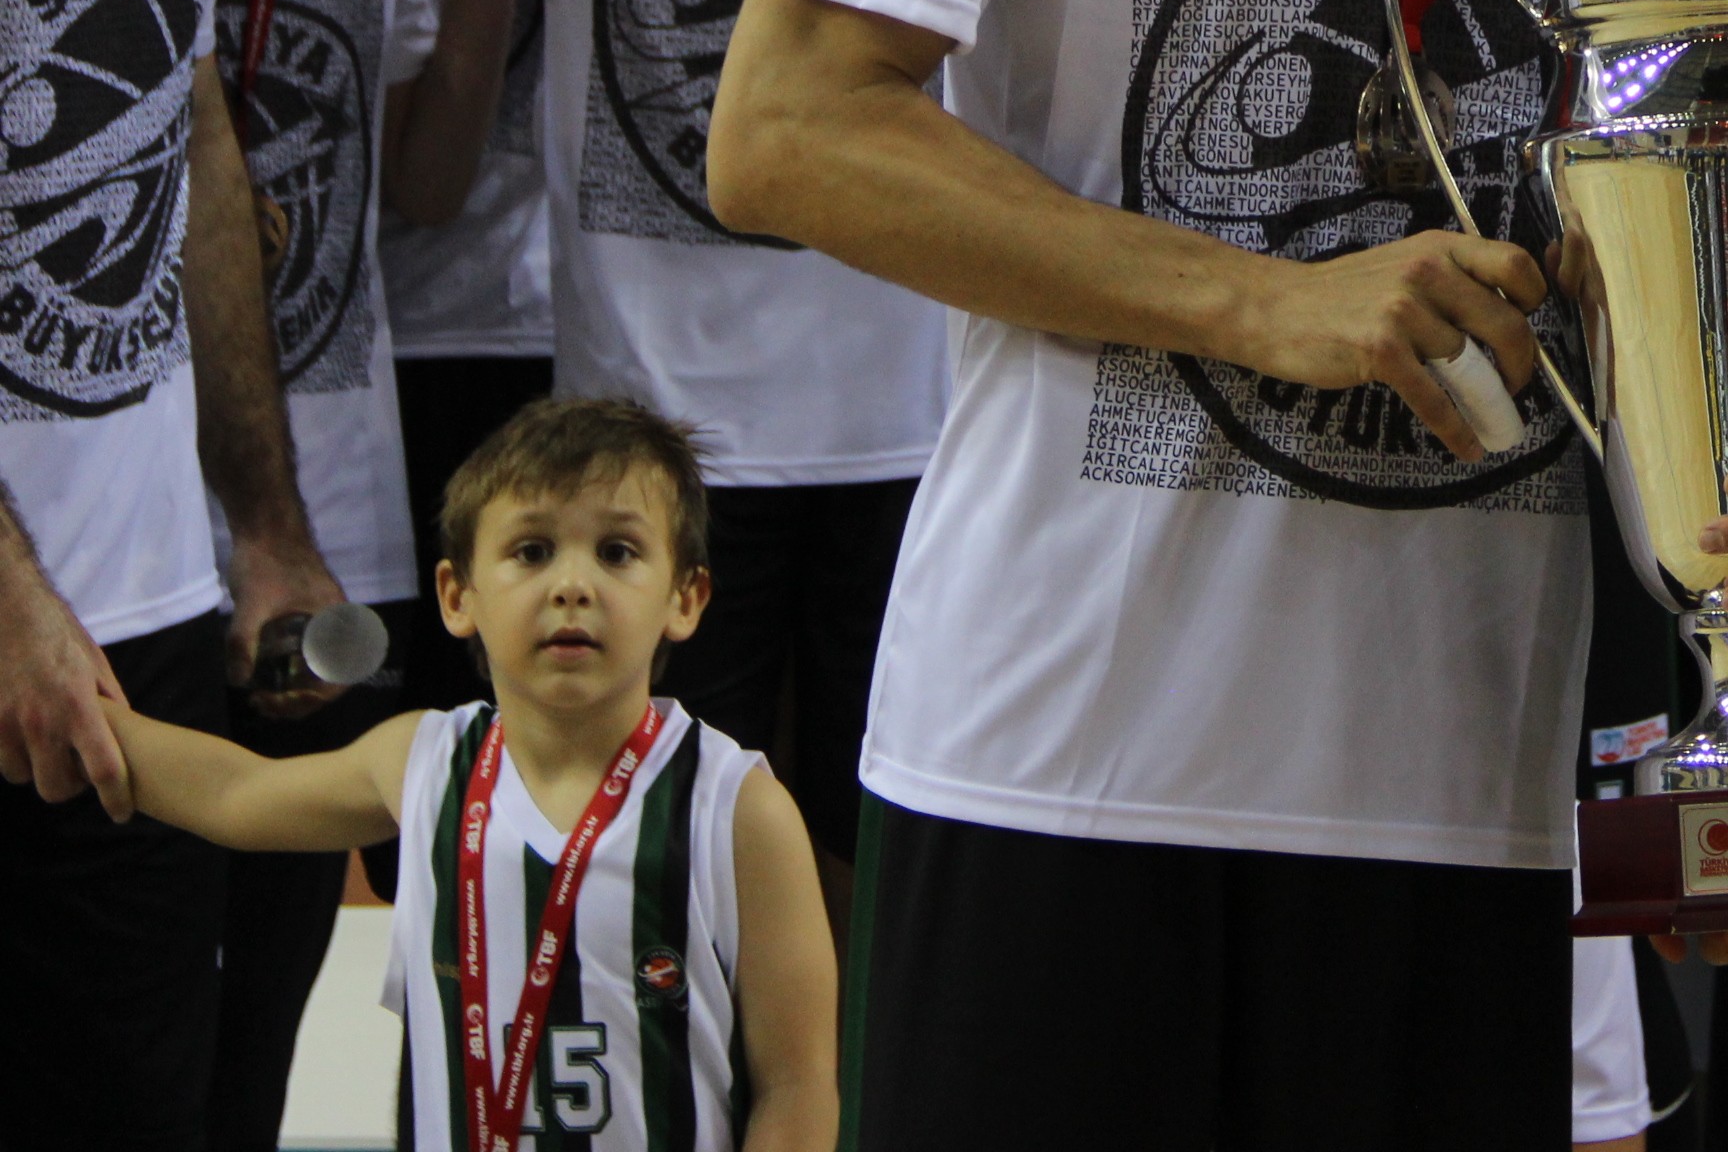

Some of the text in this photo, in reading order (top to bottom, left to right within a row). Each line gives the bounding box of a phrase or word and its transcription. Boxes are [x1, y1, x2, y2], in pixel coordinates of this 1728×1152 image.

[614, 747, 639, 779] TBF
[465, 819, 483, 854] TBF
[556, 815, 599, 906] www.tbf.org.tr
[537, 929, 559, 966] TBF
[467, 1024, 486, 1061] TBF
[504, 1012, 535, 1110] www.tbf.org.tr
